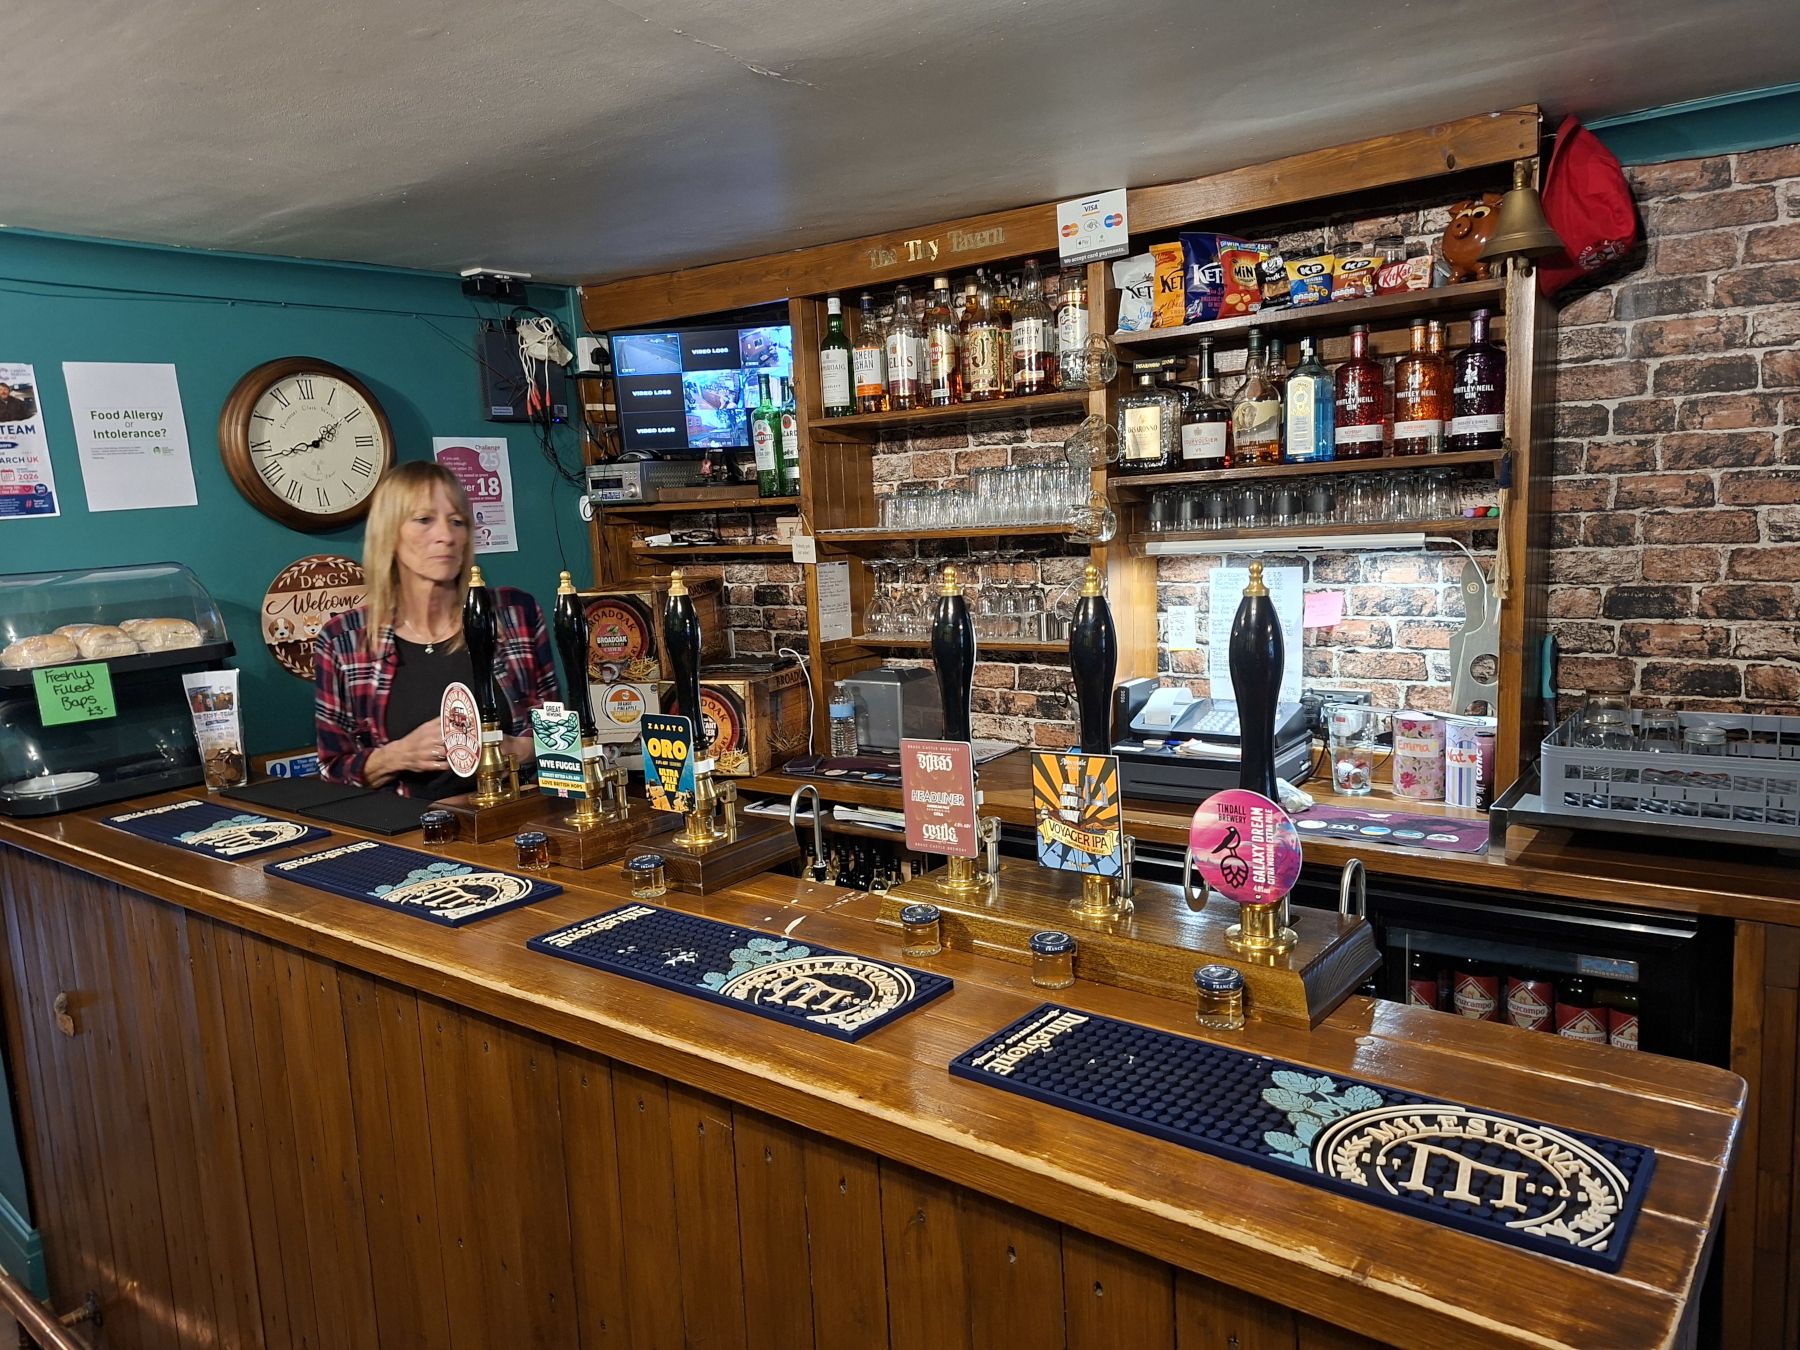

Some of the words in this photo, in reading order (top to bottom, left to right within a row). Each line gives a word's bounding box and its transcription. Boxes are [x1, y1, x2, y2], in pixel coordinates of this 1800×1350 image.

[1083, 204, 1099, 212] VISA
[948, 227, 1006, 252] Tavern
[1300, 264, 1322, 275] KP
[1344, 260, 1369, 270] KP
[1382, 267, 1413, 287] KitKat
[1160, 275, 1184, 294] KET
[1125, 285, 1154, 299] KET
[1476, 384, 1494, 392] NEILL
[1396, 391, 1420, 399] WHITLEY
[1464, 392, 1476, 400] GIN
[90, 410, 120, 420] Food
[124, 410, 164, 421] Allergy
[93, 428, 166, 440] Intolerance?
[1128, 424, 1158, 434] DISARONNO
[475, 444, 500, 452] Challenge
[480, 452, 499, 466] 25
[476, 477, 500, 496] 18
[266, 590, 368, 615] Welcome
[596, 636, 628, 644] BROADOAK
[44, 669, 95, 684] Freshly
[53, 678, 94, 696] Filled
[62, 696, 97, 711] Baps
[648, 723, 684, 732] ZAPATO
[648, 738, 687, 760] ORO
[1397, 741, 1430, 752] Emma
[1447, 748, 1466, 762] Nat
[539, 759, 555, 768] WYE
[555, 760, 581, 771] FUGGLE
[659, 768, 679, 778] ULTRA
[662, 776, 677, 785] PALE
[664, 783, 676, 792] ALE
[911, 790, 965, 806] HEADLINER
[1217, 803, 1246, 815] TINDALL
[1219, 814, 1246, 824] BREWERY
[1250, 807, 1265, 842] DREAM
[1048, 820, 1090, 846] VOYAGER
[1092, 836, 1109, 849] IPA
[1265, 825, 1273, 843] EXTRA
[1252, 844, 1266, 883] GALAXY
[1364, 1115, 1592, 1179] MILESTONE
